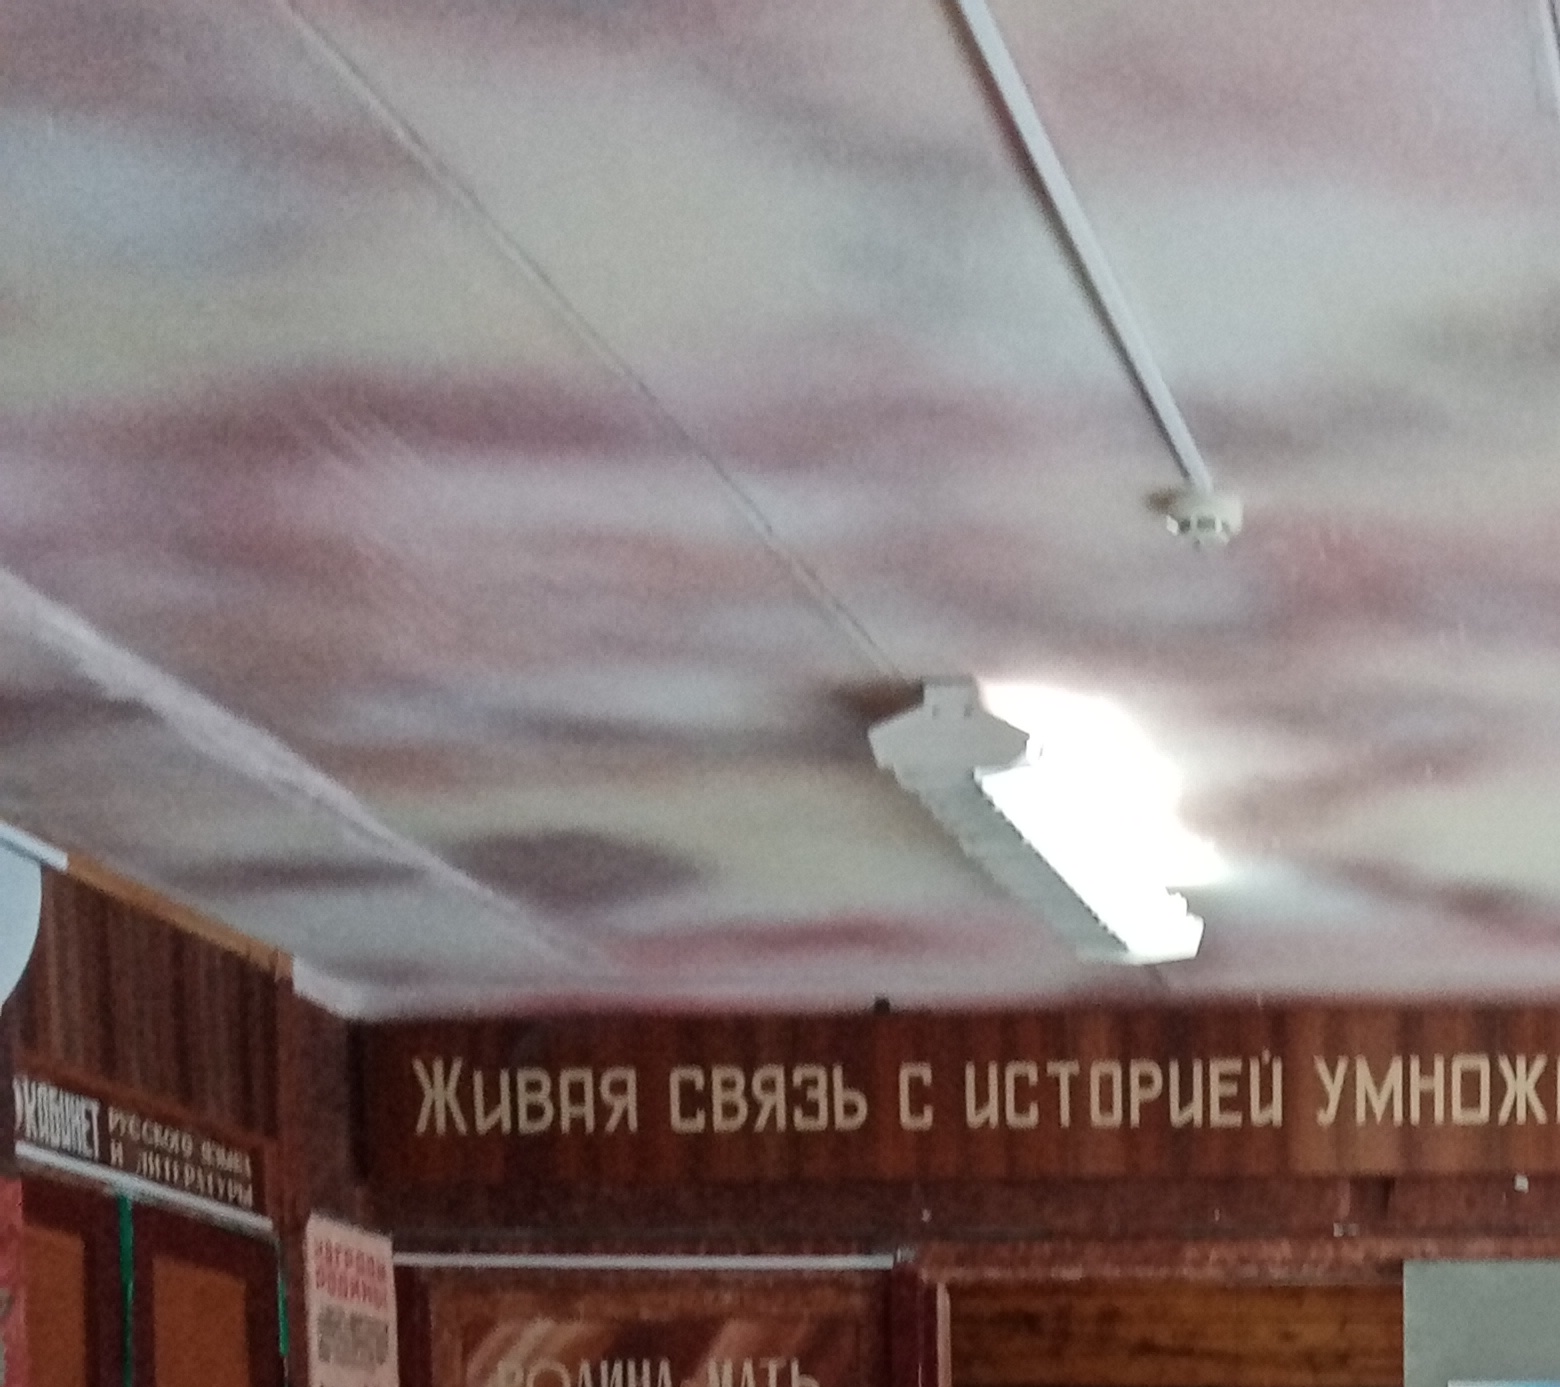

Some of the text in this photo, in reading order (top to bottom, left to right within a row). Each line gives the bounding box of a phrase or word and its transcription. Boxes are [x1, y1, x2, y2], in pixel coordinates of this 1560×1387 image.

[668, 1061, 869, 1135] СВЯЗЬ
[897, 1060, 935, 1132] С
[964, 1047, 1284, 1131] ИСТОРИЕЙ
